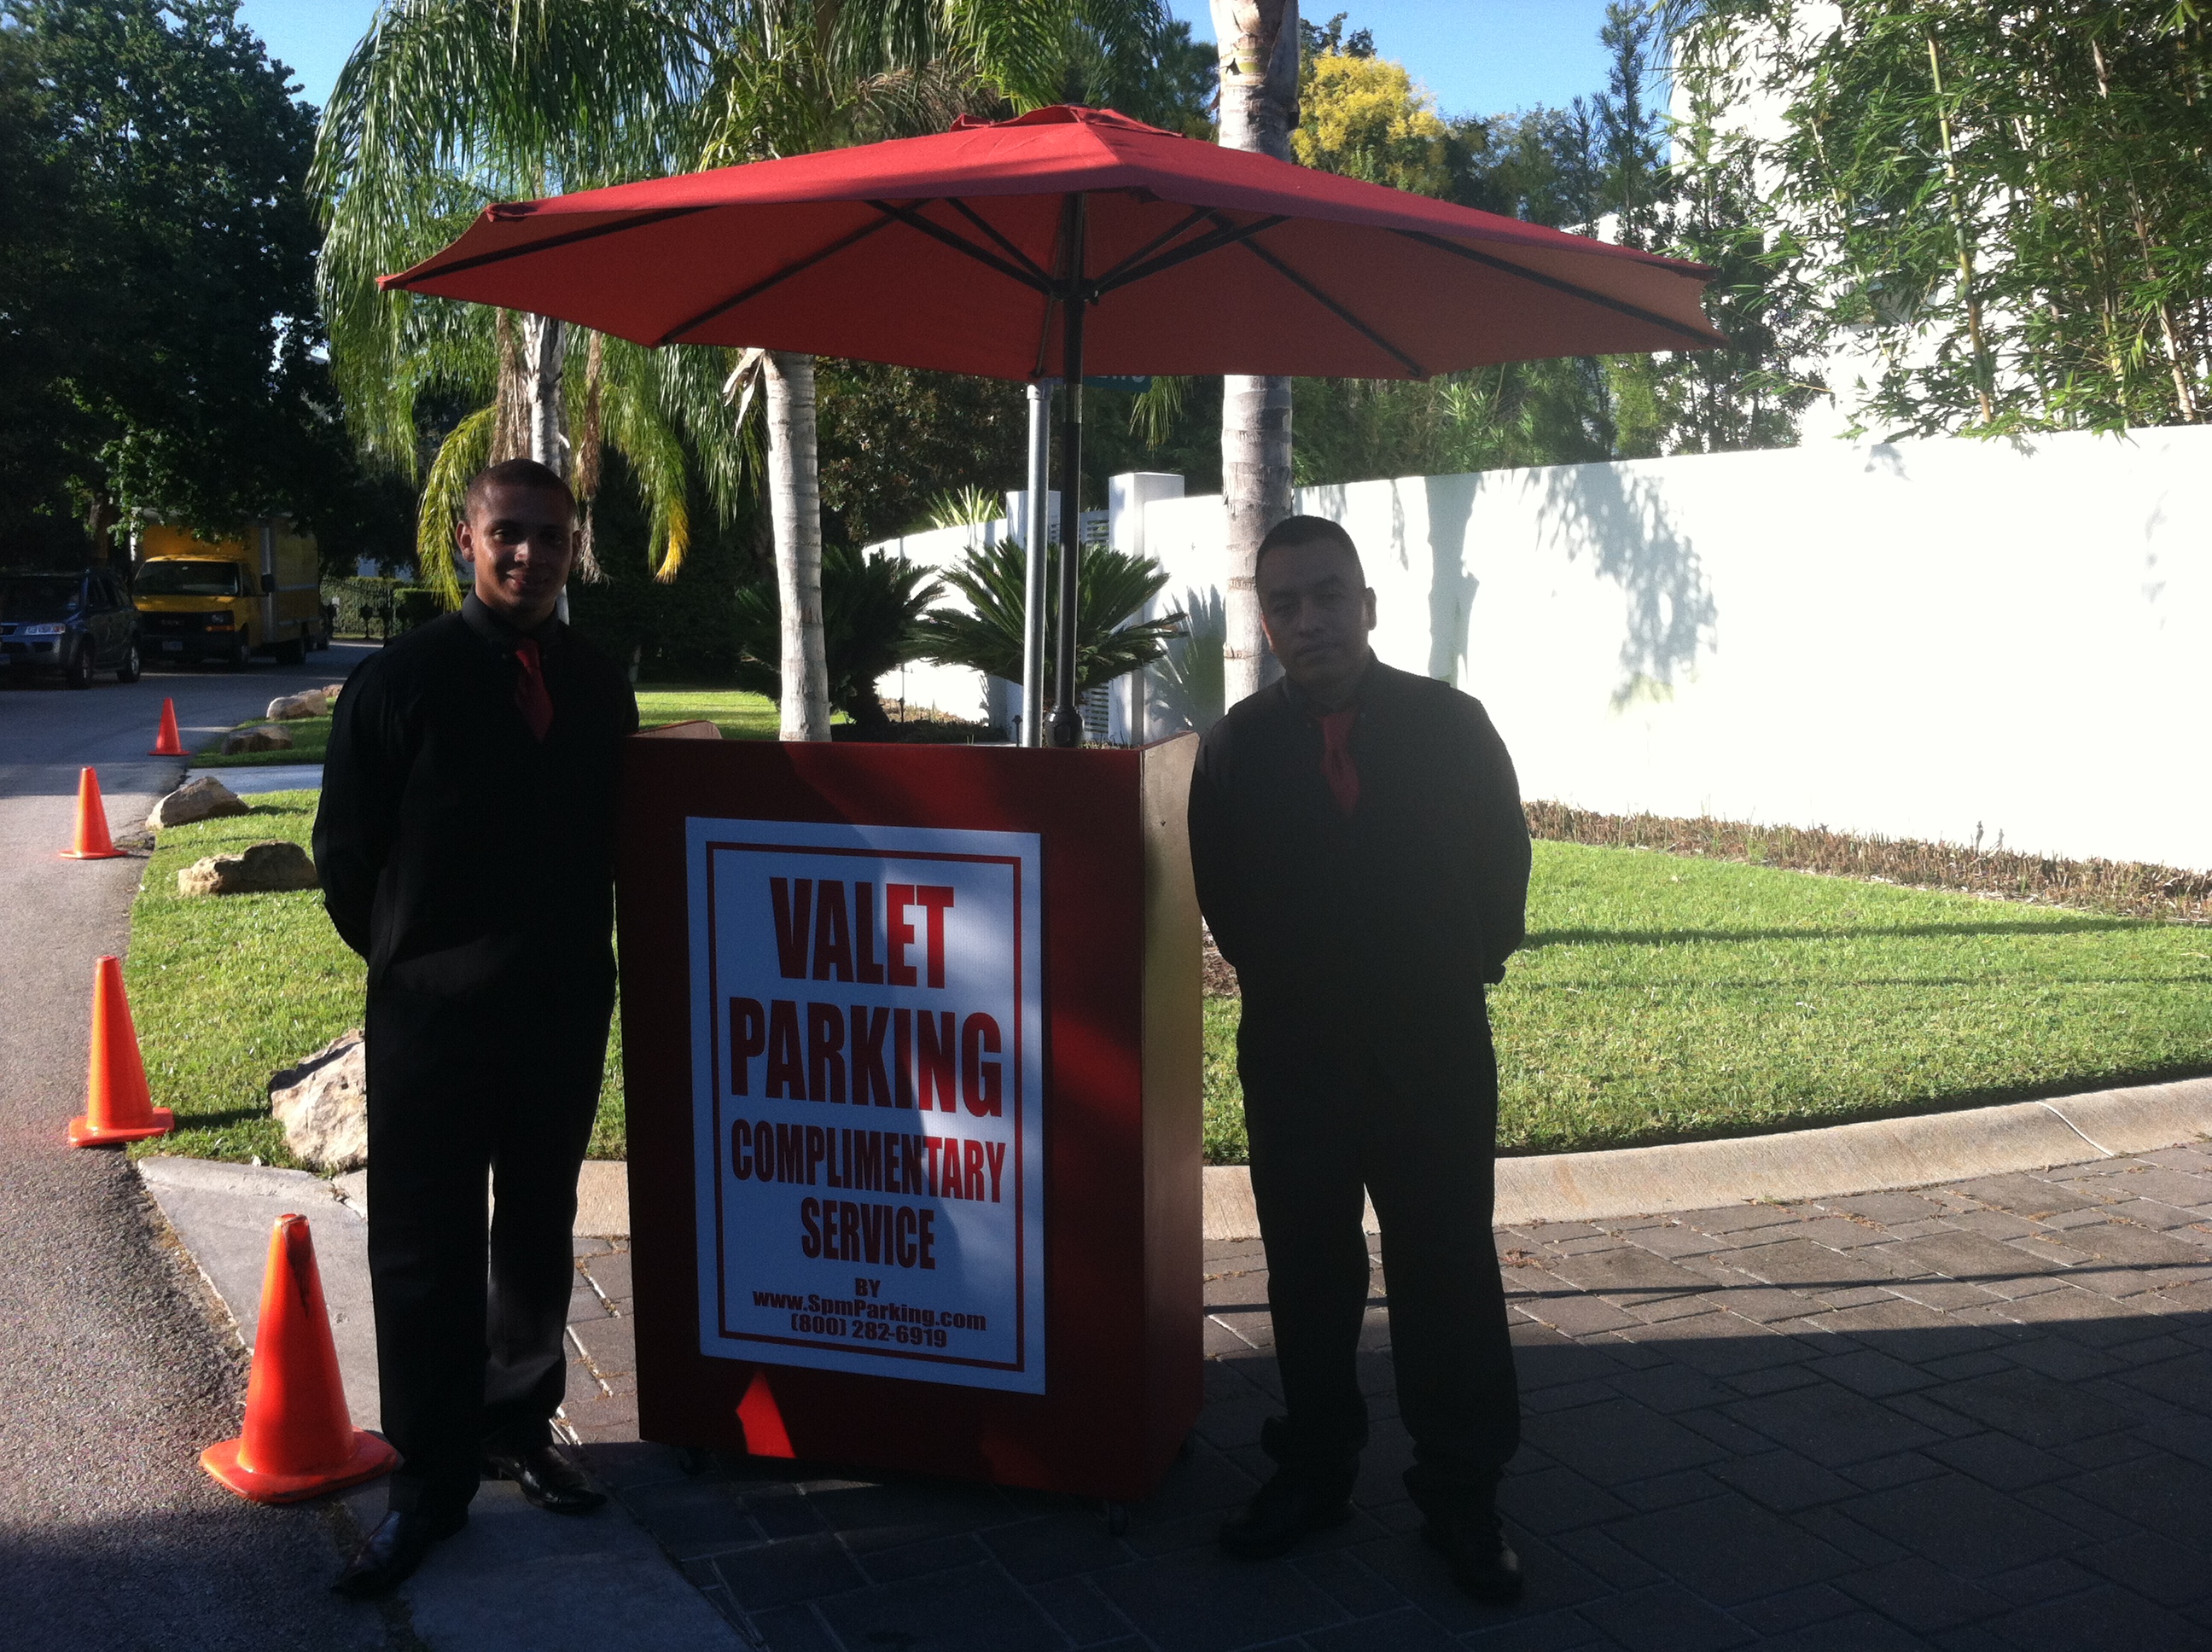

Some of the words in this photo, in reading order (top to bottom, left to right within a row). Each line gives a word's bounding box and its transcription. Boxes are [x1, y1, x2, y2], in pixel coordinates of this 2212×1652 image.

[769, 876, 955, 990] VALET
[730, 996, 1004, 1118] PARKING
[731, 1119, 1006, 1203] COMPLIMENTARY
[800, 1196, 936, 1270] SERVICE
[753, 1291, 987, 1331] www.SpmParking.com
[855, 1277, 881, 1297] BY
[791, 1313, 847, 1336] (800)
[852, 1320, 947, 1347] 282-6919
